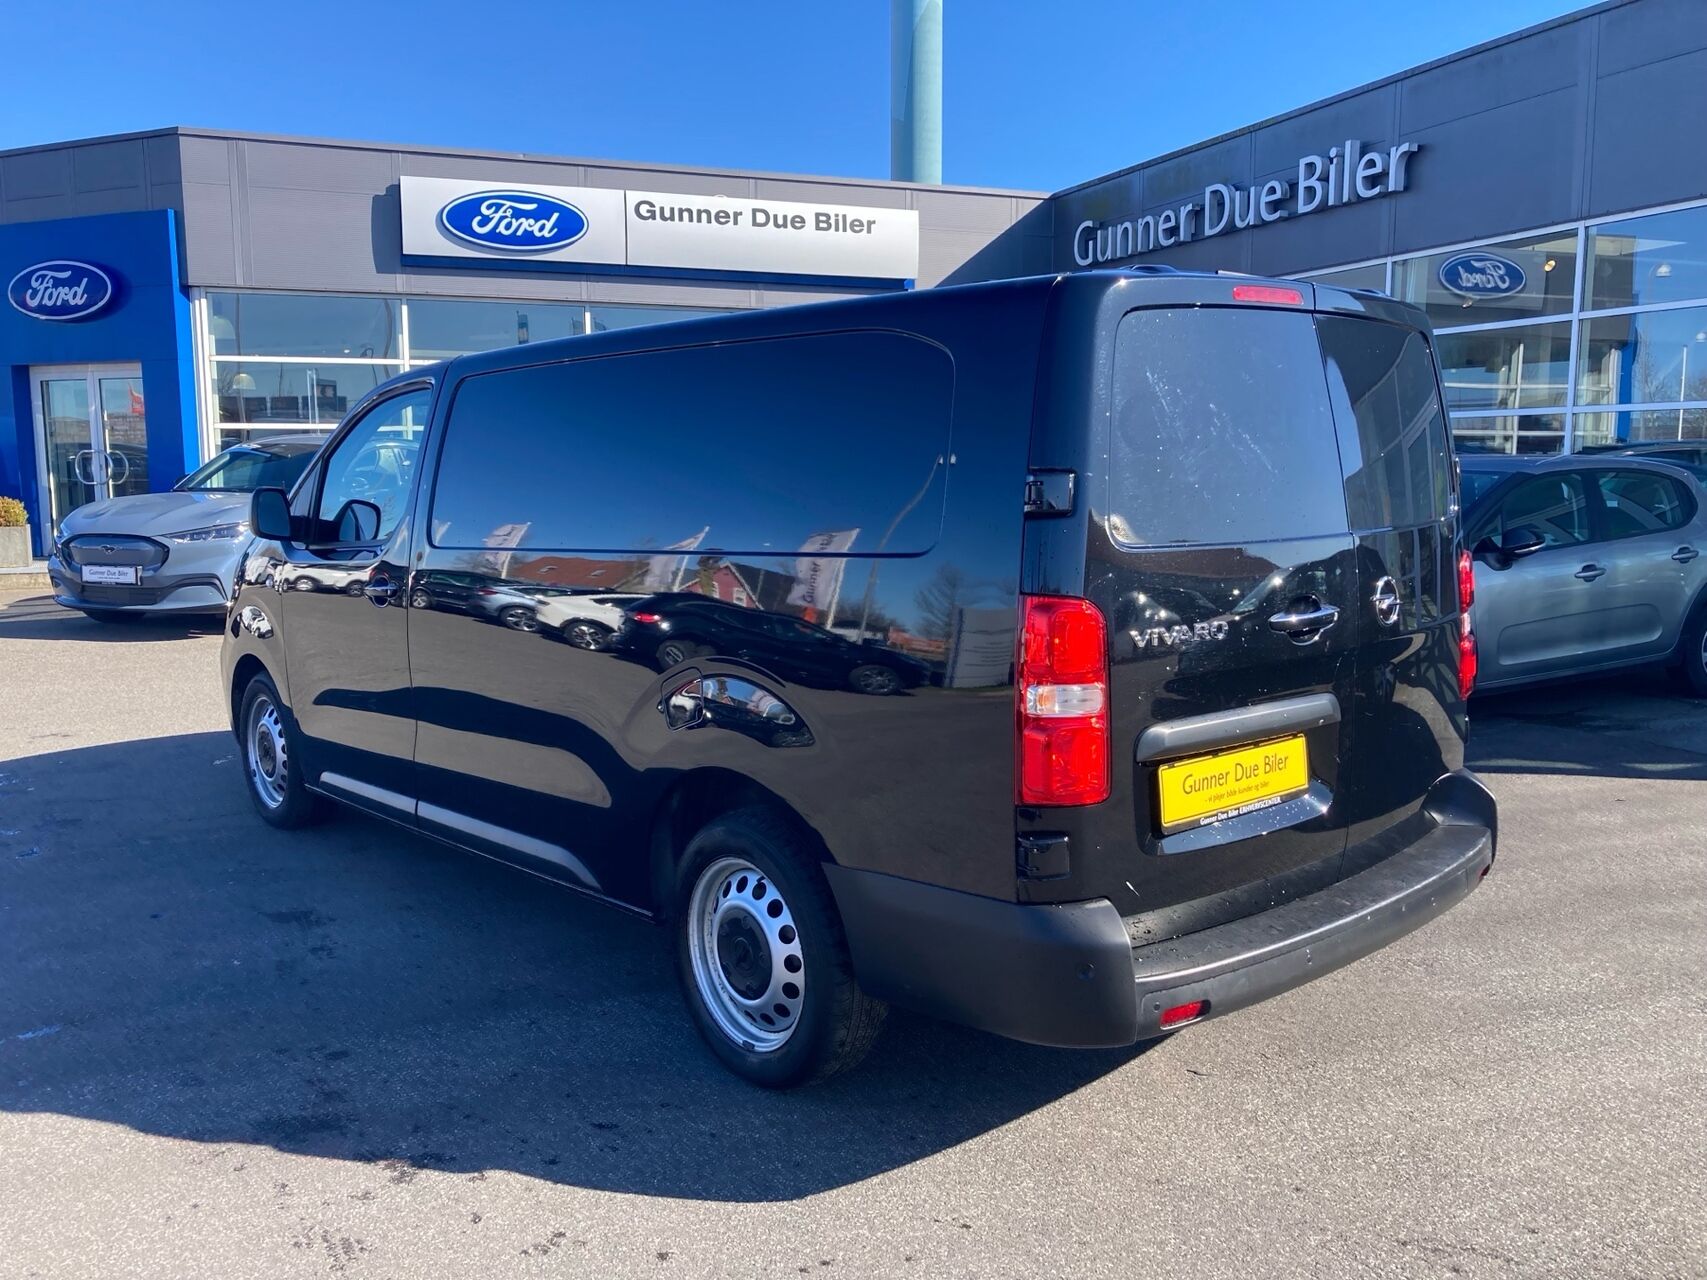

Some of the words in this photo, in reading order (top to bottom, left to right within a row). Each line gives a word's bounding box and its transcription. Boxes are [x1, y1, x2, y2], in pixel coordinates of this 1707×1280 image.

[471, 199, 560, 238] Ford
[633, 199, 743, 226] Gunner
[751, 207, 806, 230] Due
[814, 212, 876, 234] Biler
[1073, 202, 1200, 267] Gunner
[1204, 179, 1289, 237] Due
[1297, 139, 1419, 214] Biler
[26, 270, 88, 307] Ford
[1128, 621, 1229, 648] VIVARO
[1182, 769, 1231, 795] Gunner
[1234, 762, 1259, 782] Due
[1264, 753, 1288, 774] Biler
[1200, 815, 1217, 825] Gunner
[1217, 812, 1228, 820] Due
